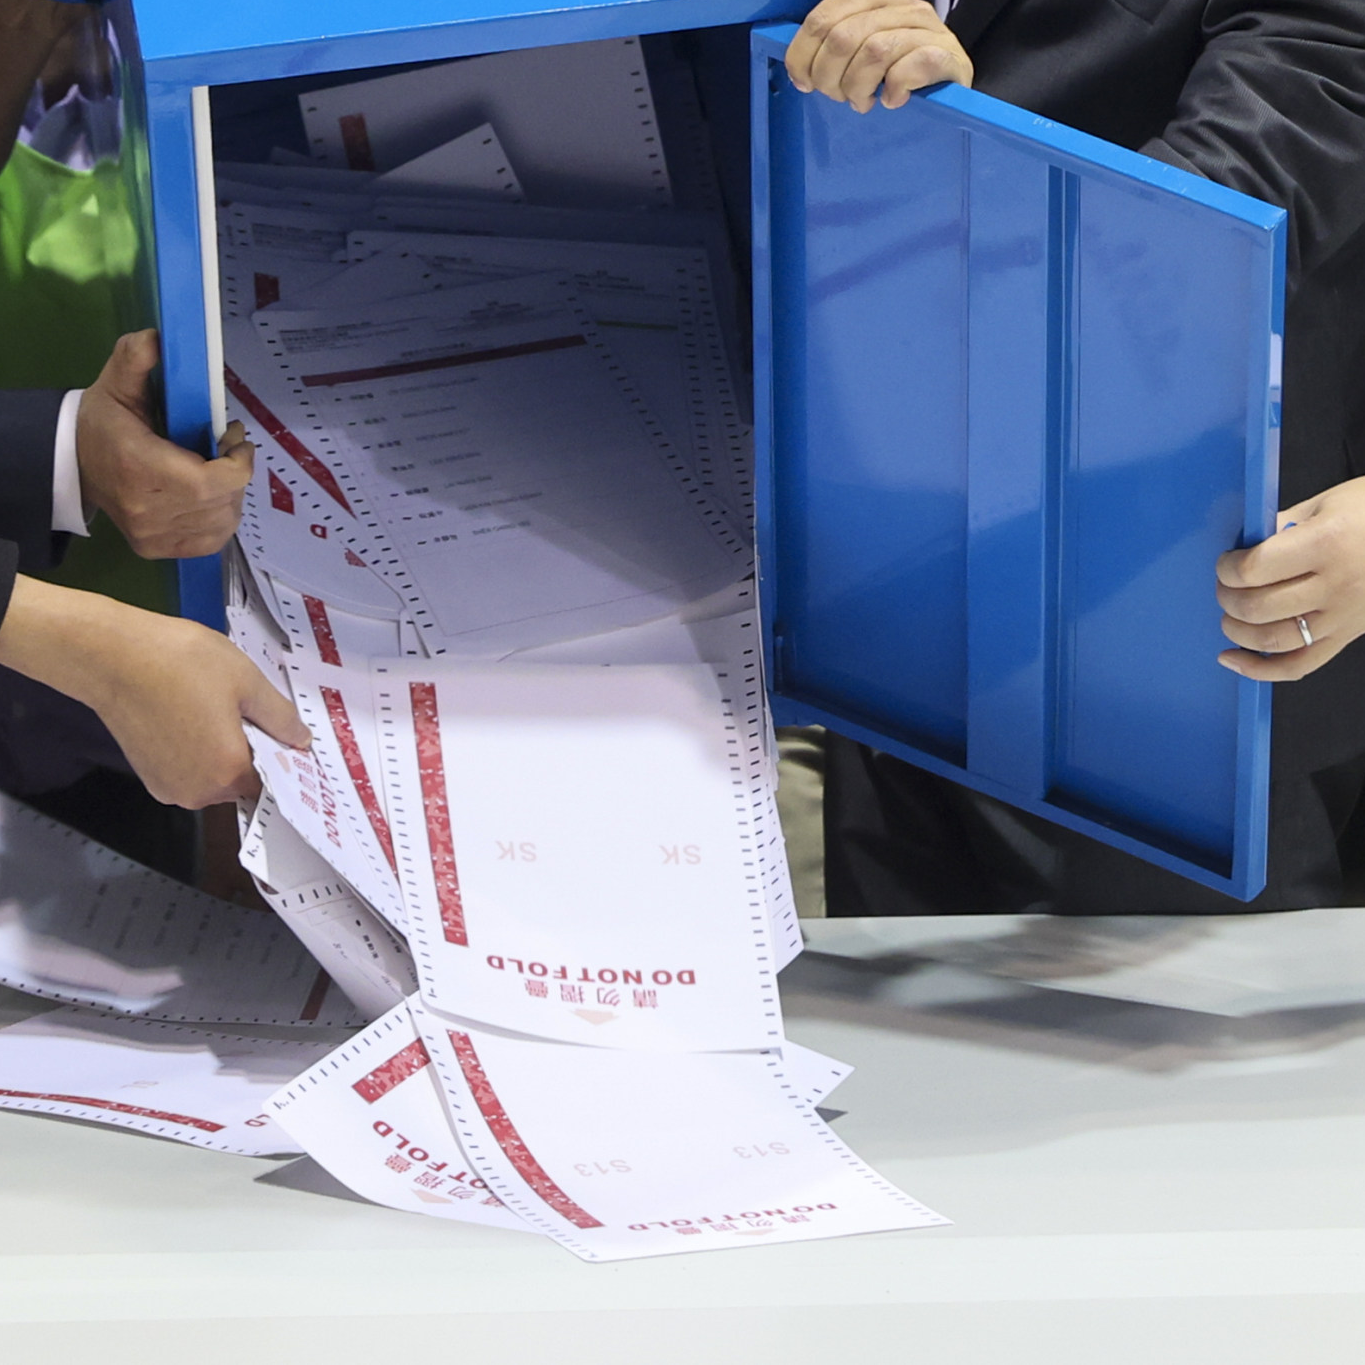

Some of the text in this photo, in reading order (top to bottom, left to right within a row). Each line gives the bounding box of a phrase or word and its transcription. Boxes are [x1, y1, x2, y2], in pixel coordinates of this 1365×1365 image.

[494, 839, 538, 863] SK
[658, 843, 703, 866] SK
[485, 954, 696, 986] DO NOT FOLD
[371, 1119, 490, 1192] OT FOLD
[732, 1140, 791, 1160] S13
[572, 1158, 633, 1178] S13
[627, 1202, 839, 1232] DO NOT FOLD
